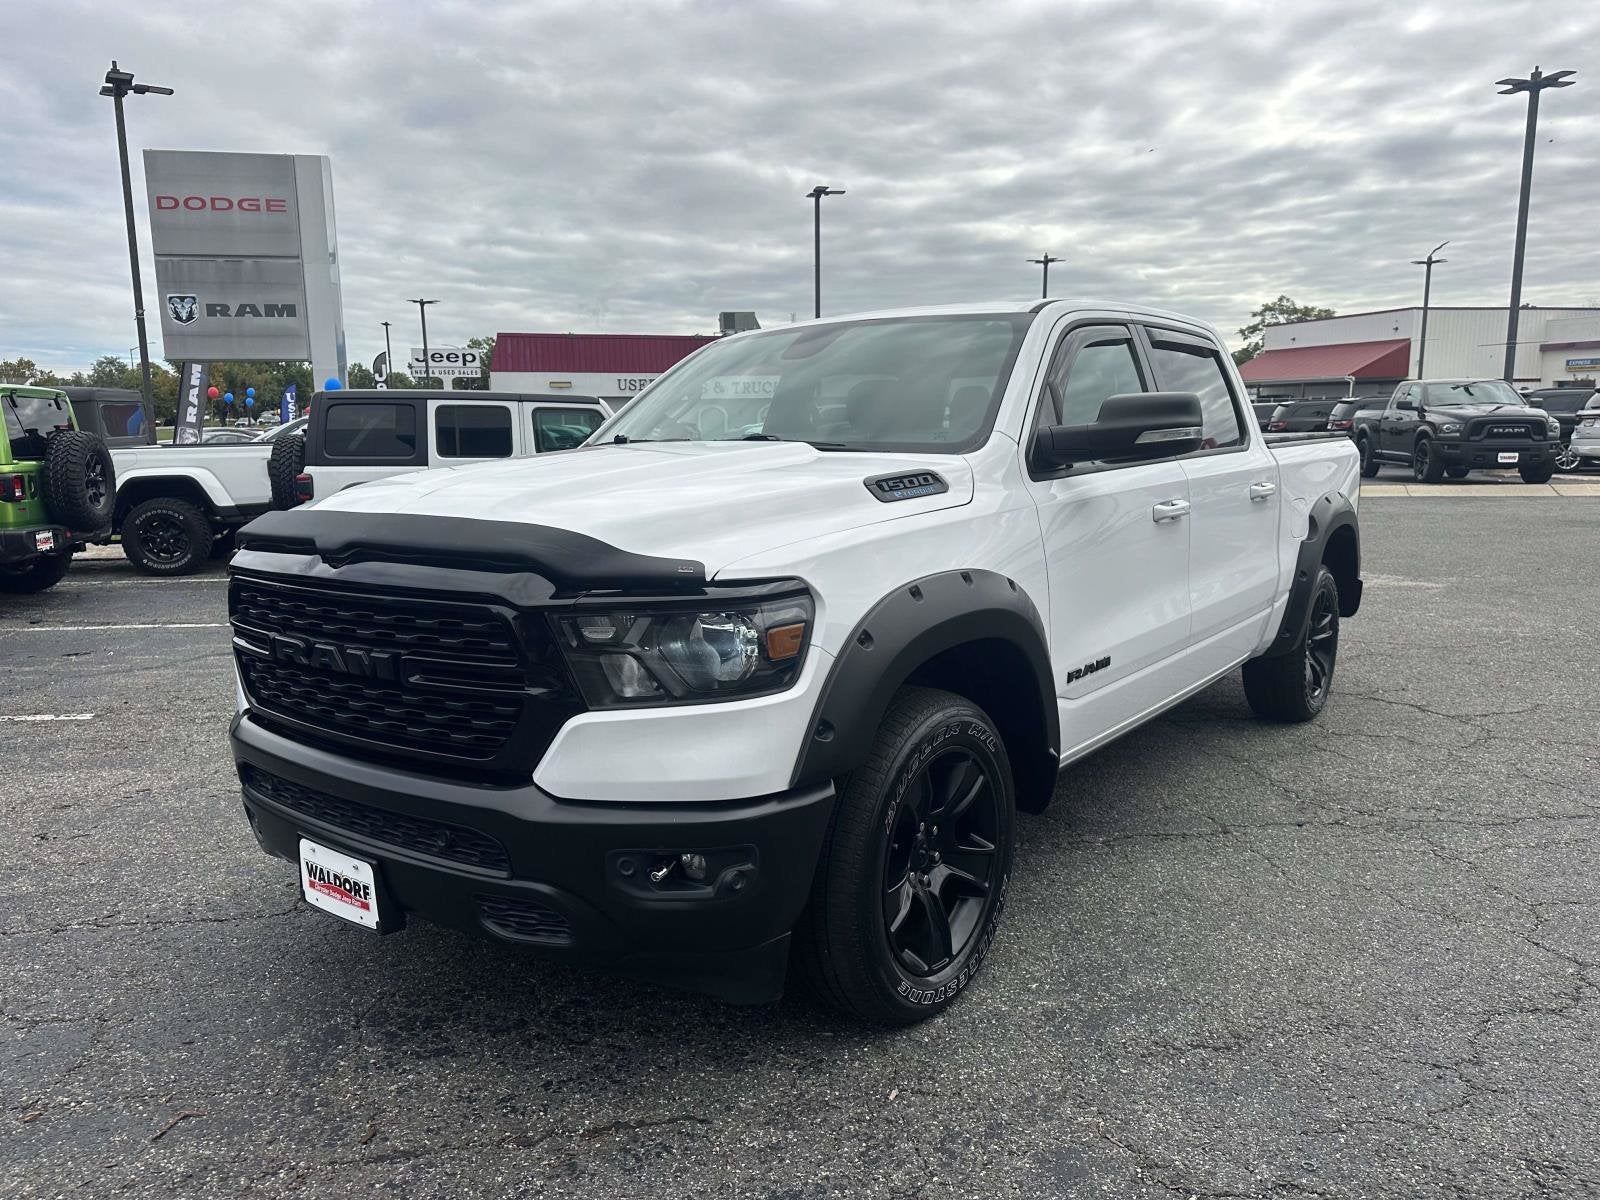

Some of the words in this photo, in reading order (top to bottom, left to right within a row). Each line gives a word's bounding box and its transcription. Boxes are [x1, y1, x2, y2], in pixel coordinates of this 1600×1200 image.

[155, 195, 287, 212] DODGE
[205, 303, 297, 318] RAM
[186, 363, 202, 423] RAM
[617, 378, 655, 391] USE
[880, 475, 933, 491] 1500
[275, 636, 396, 682] RAM
[1067, 655, 1111, 684] RAM
[306, 861, 370, 900] WALDORF
